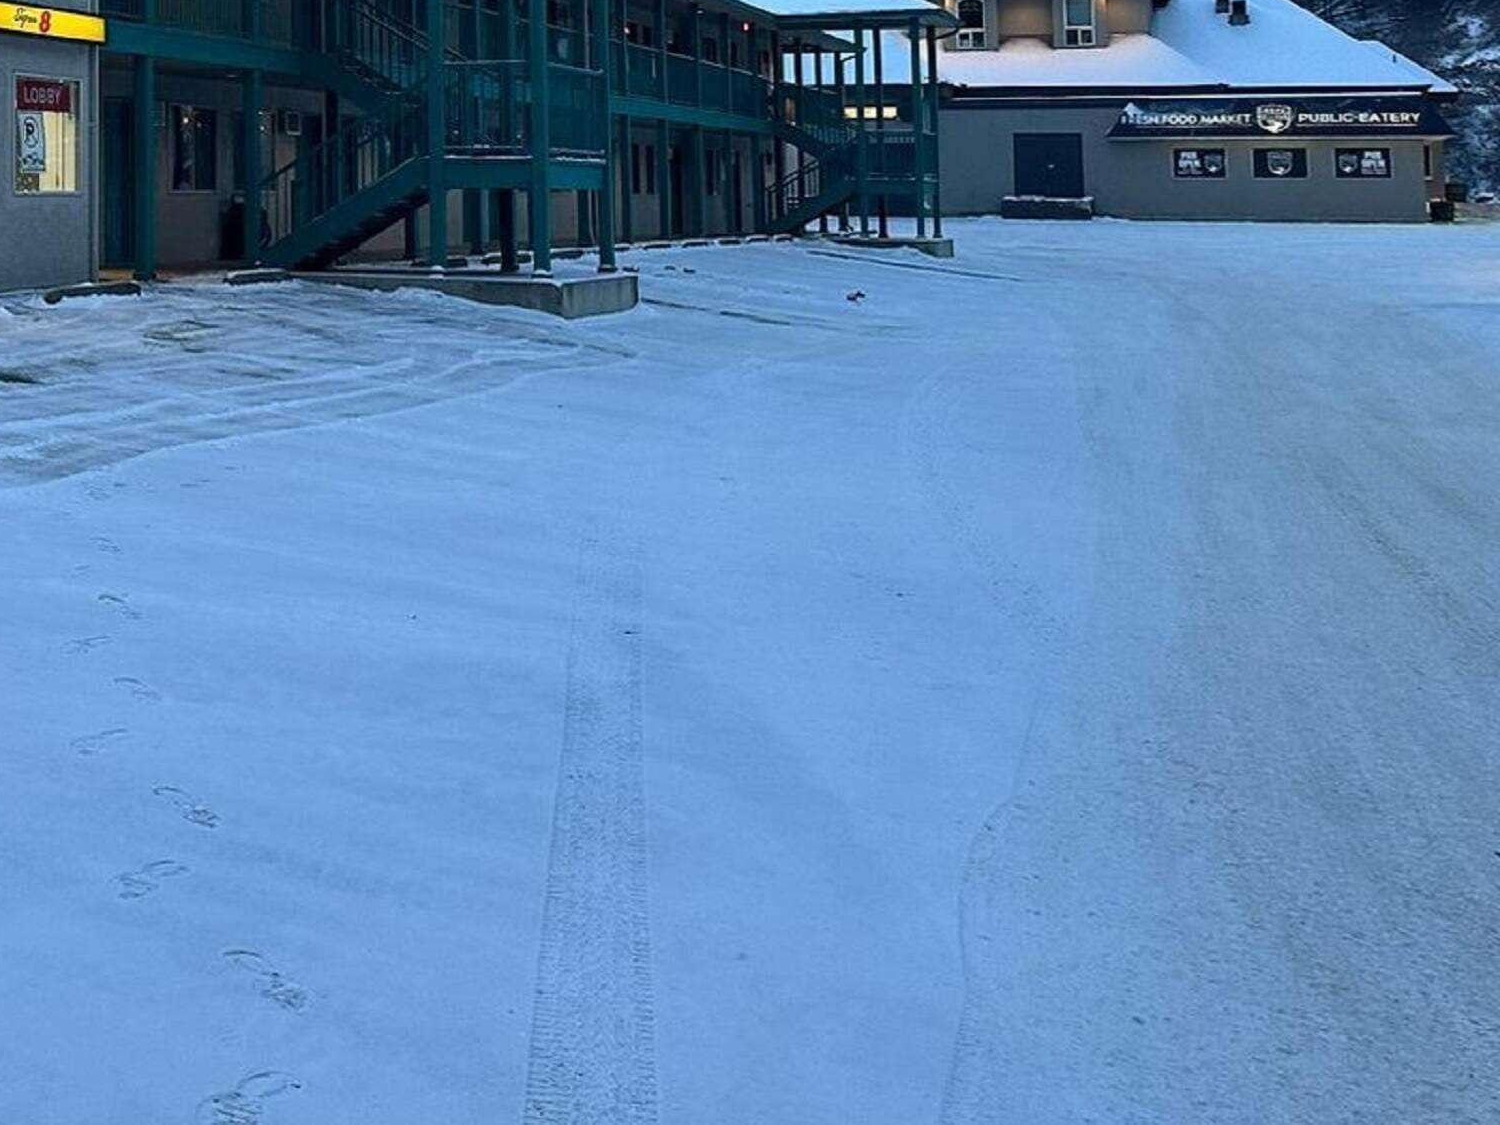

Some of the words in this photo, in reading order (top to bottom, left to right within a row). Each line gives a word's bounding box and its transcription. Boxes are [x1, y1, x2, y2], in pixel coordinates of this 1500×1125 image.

[39, 10, 51, 33] 8
[23, 85, 63, 105] LOBBY
[1161, 114, 1198, 125] FOOD
[1200, 113, 1252, 125] MARKET
